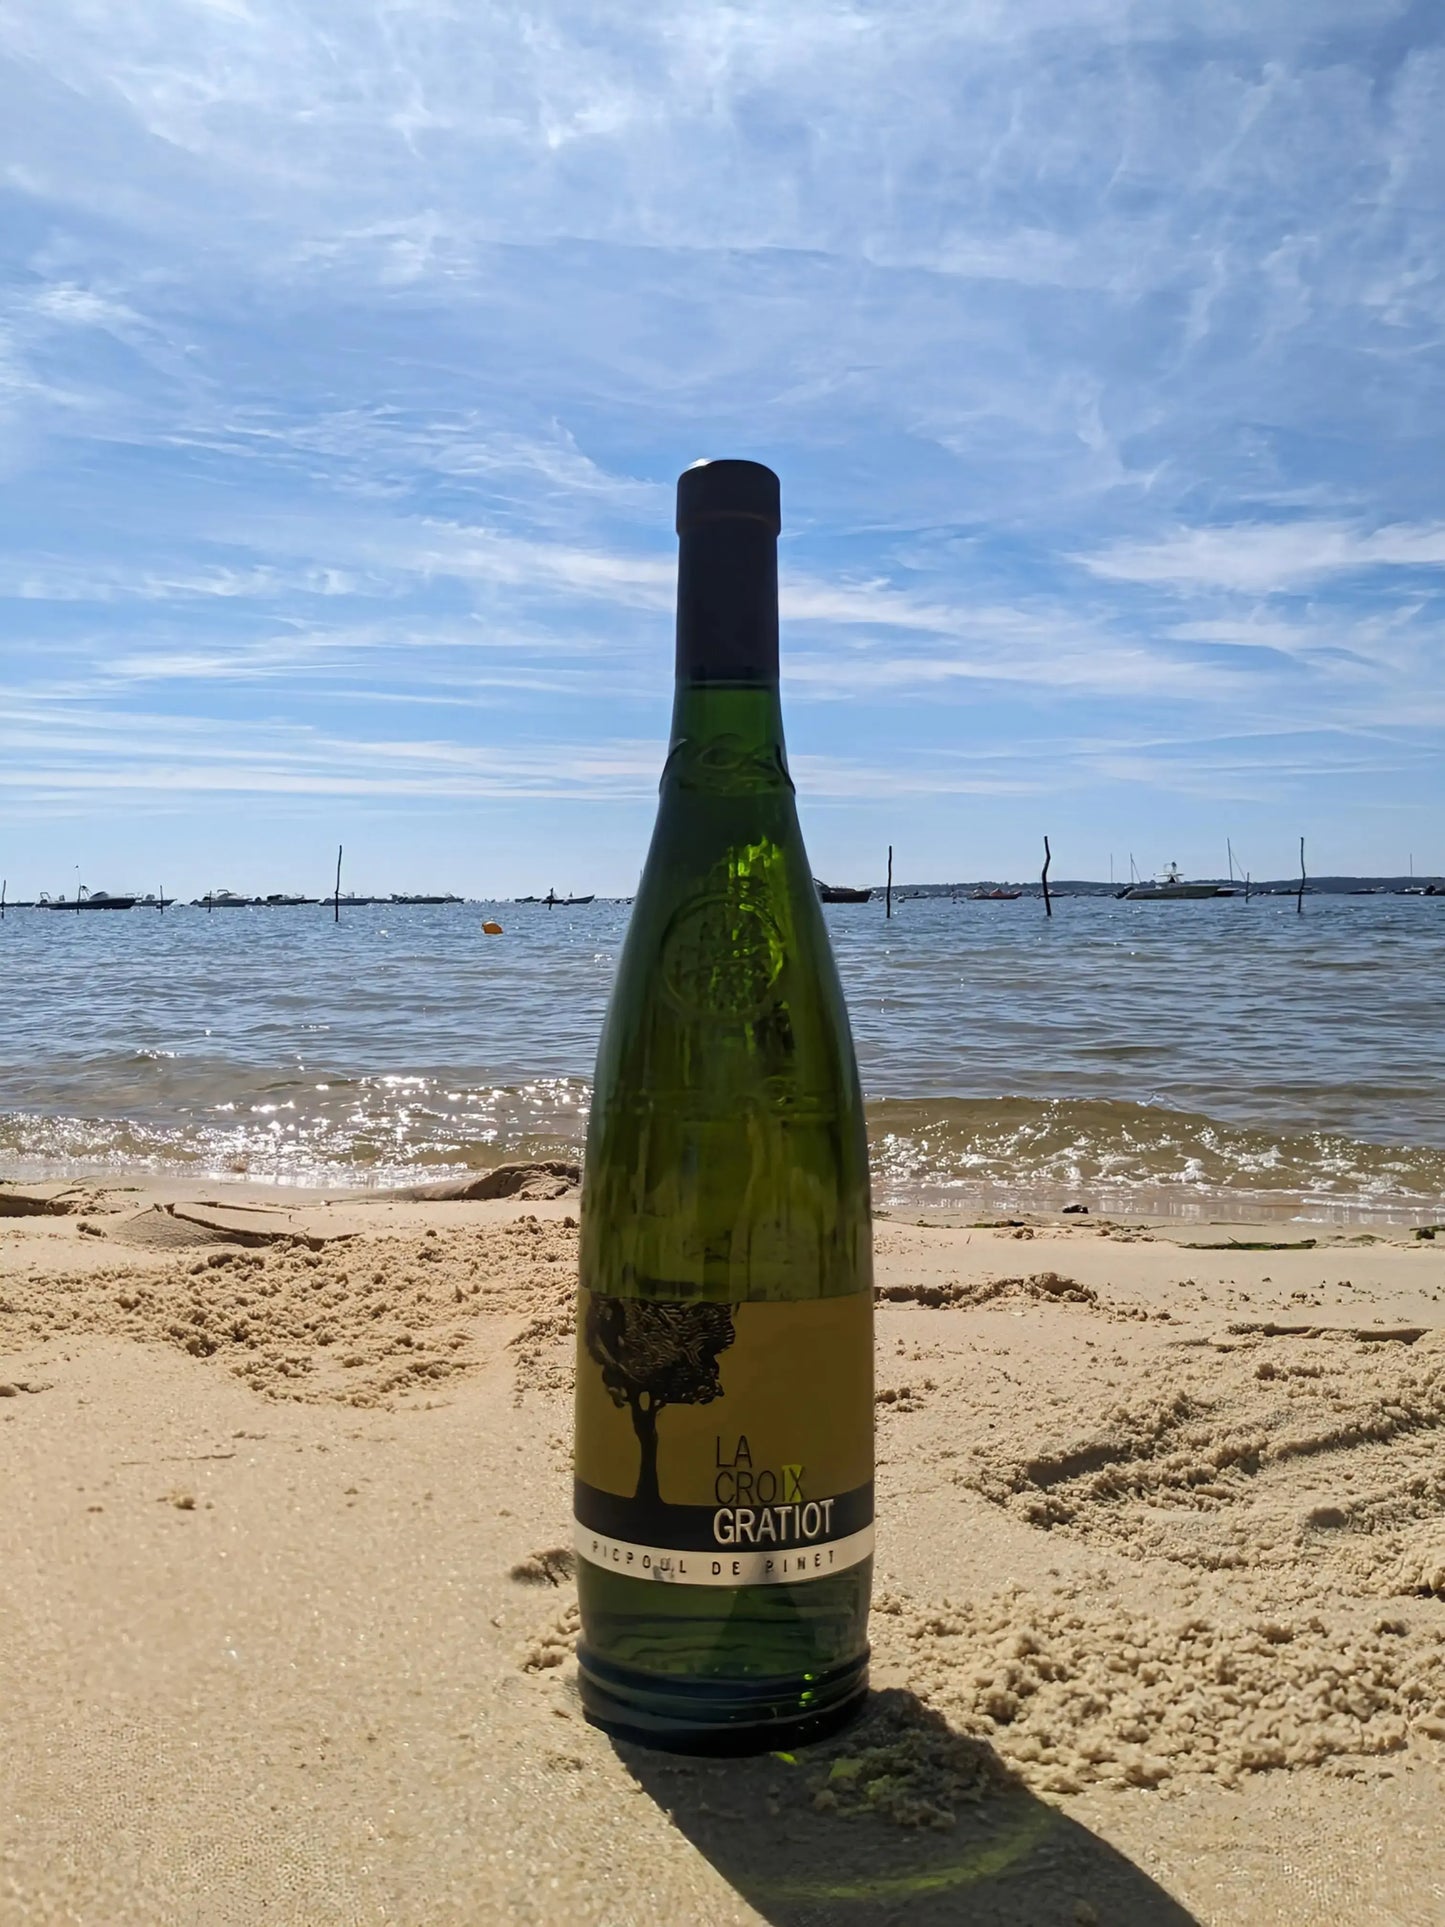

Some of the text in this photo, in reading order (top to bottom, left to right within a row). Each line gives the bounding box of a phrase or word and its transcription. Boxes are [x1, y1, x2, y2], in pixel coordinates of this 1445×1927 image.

[716, 1435, 752, 1467] LA
[715, 1468, 804, 1505] CROIX
[713, 1499, 834, 1544] GRATIOT
[592, 1540, 835, 1575] PICPOUL DE PINET
